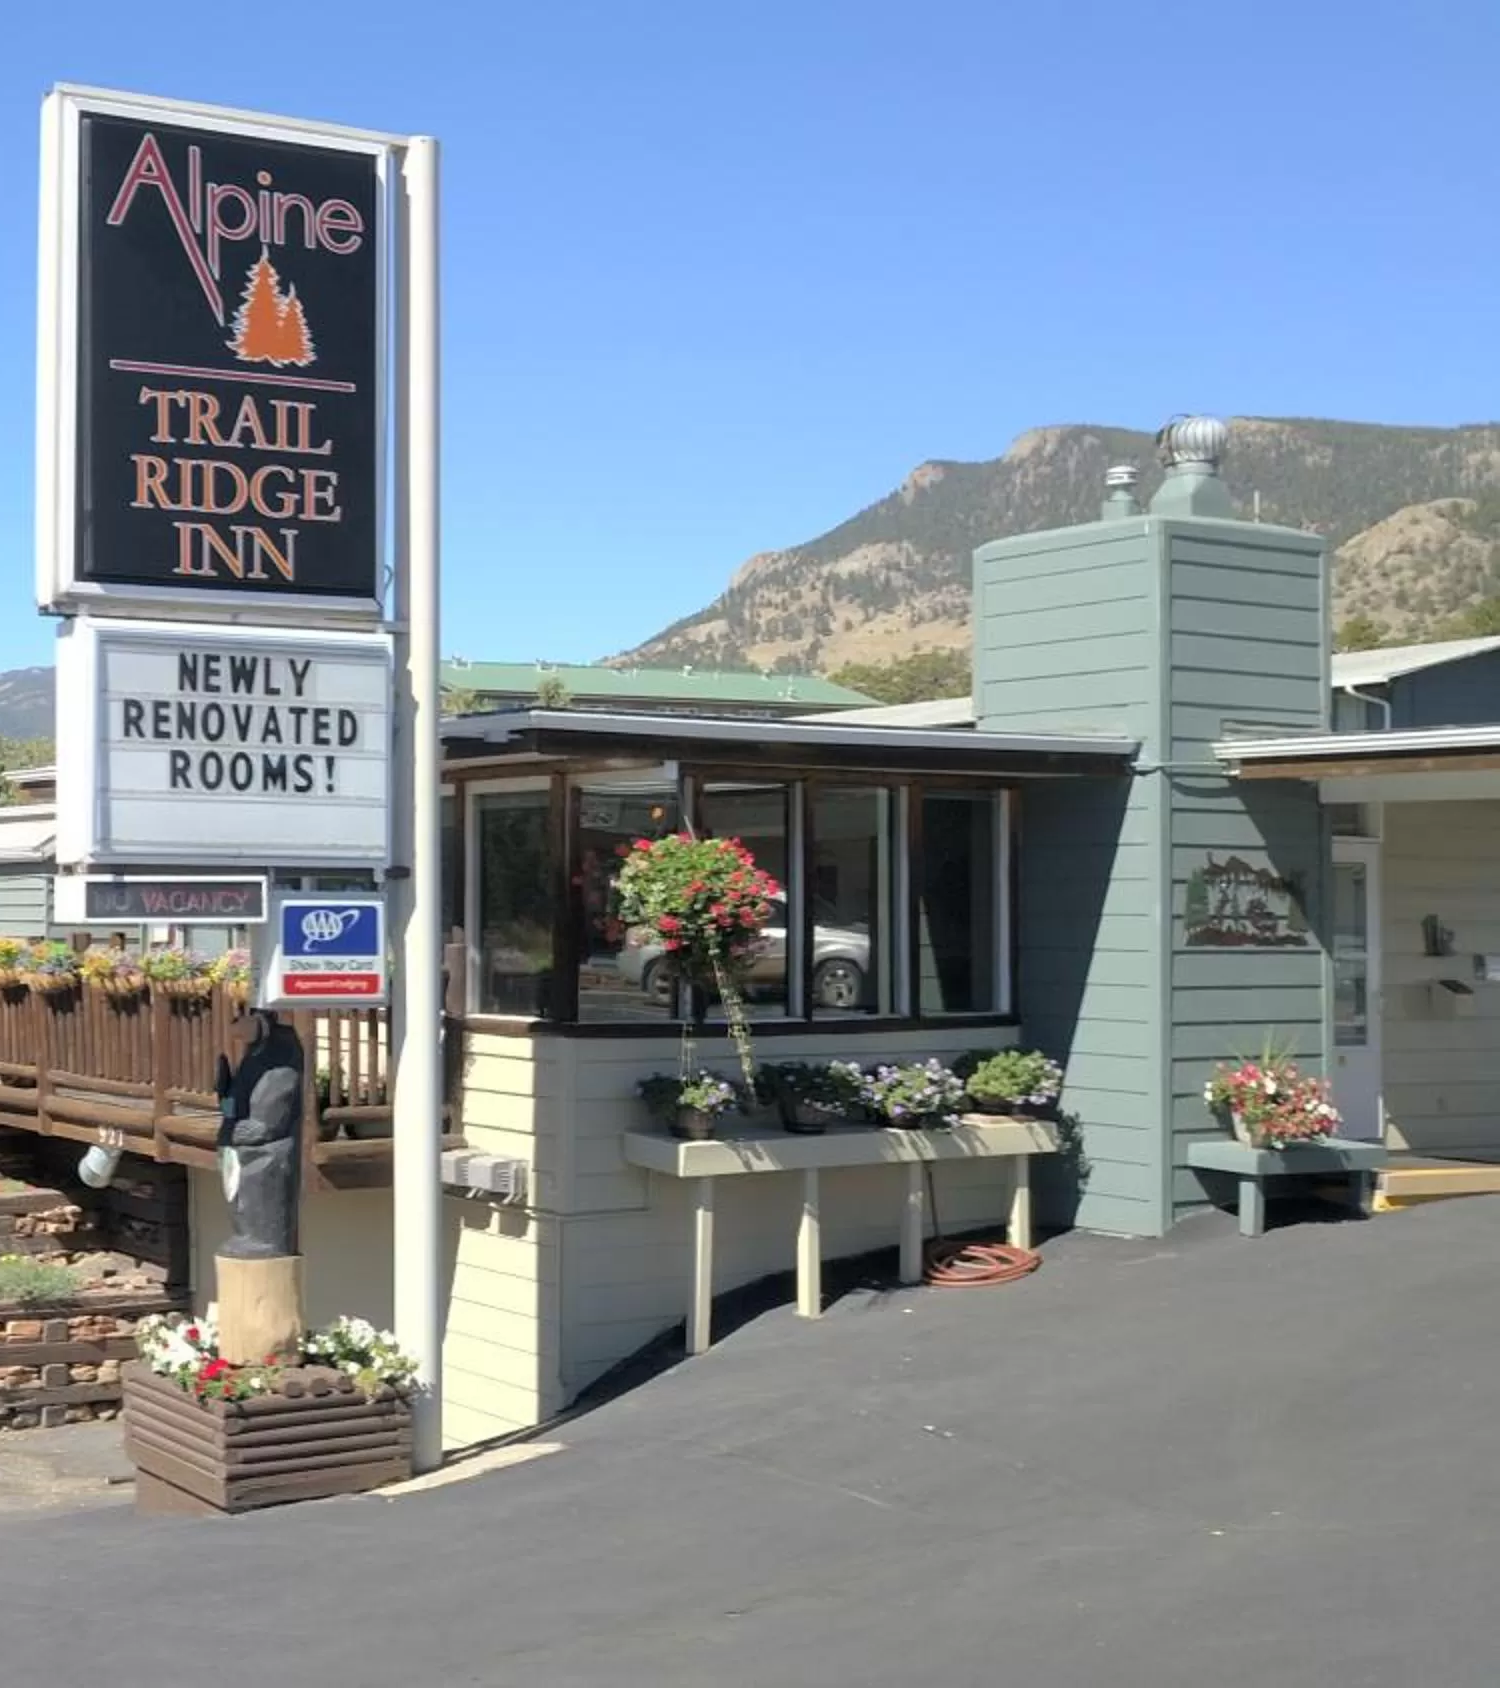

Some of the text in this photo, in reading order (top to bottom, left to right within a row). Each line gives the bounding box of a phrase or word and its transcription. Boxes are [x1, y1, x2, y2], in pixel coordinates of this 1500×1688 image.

[107, 133, 364, 327] Alpine
[140, 386, 332, 454] TRAIL
[130, 455, 341, 521] RIDGE
[173, 521, 299, 582] INN
[179, 652, 312, 696] NEWLY
[123, 699, 358, 747] RENOVATED
[169, 749, 337, 793] ROOMS!
[140, 889, 250, 913] VACANCY
[305, 911, 340, 938] AAA
